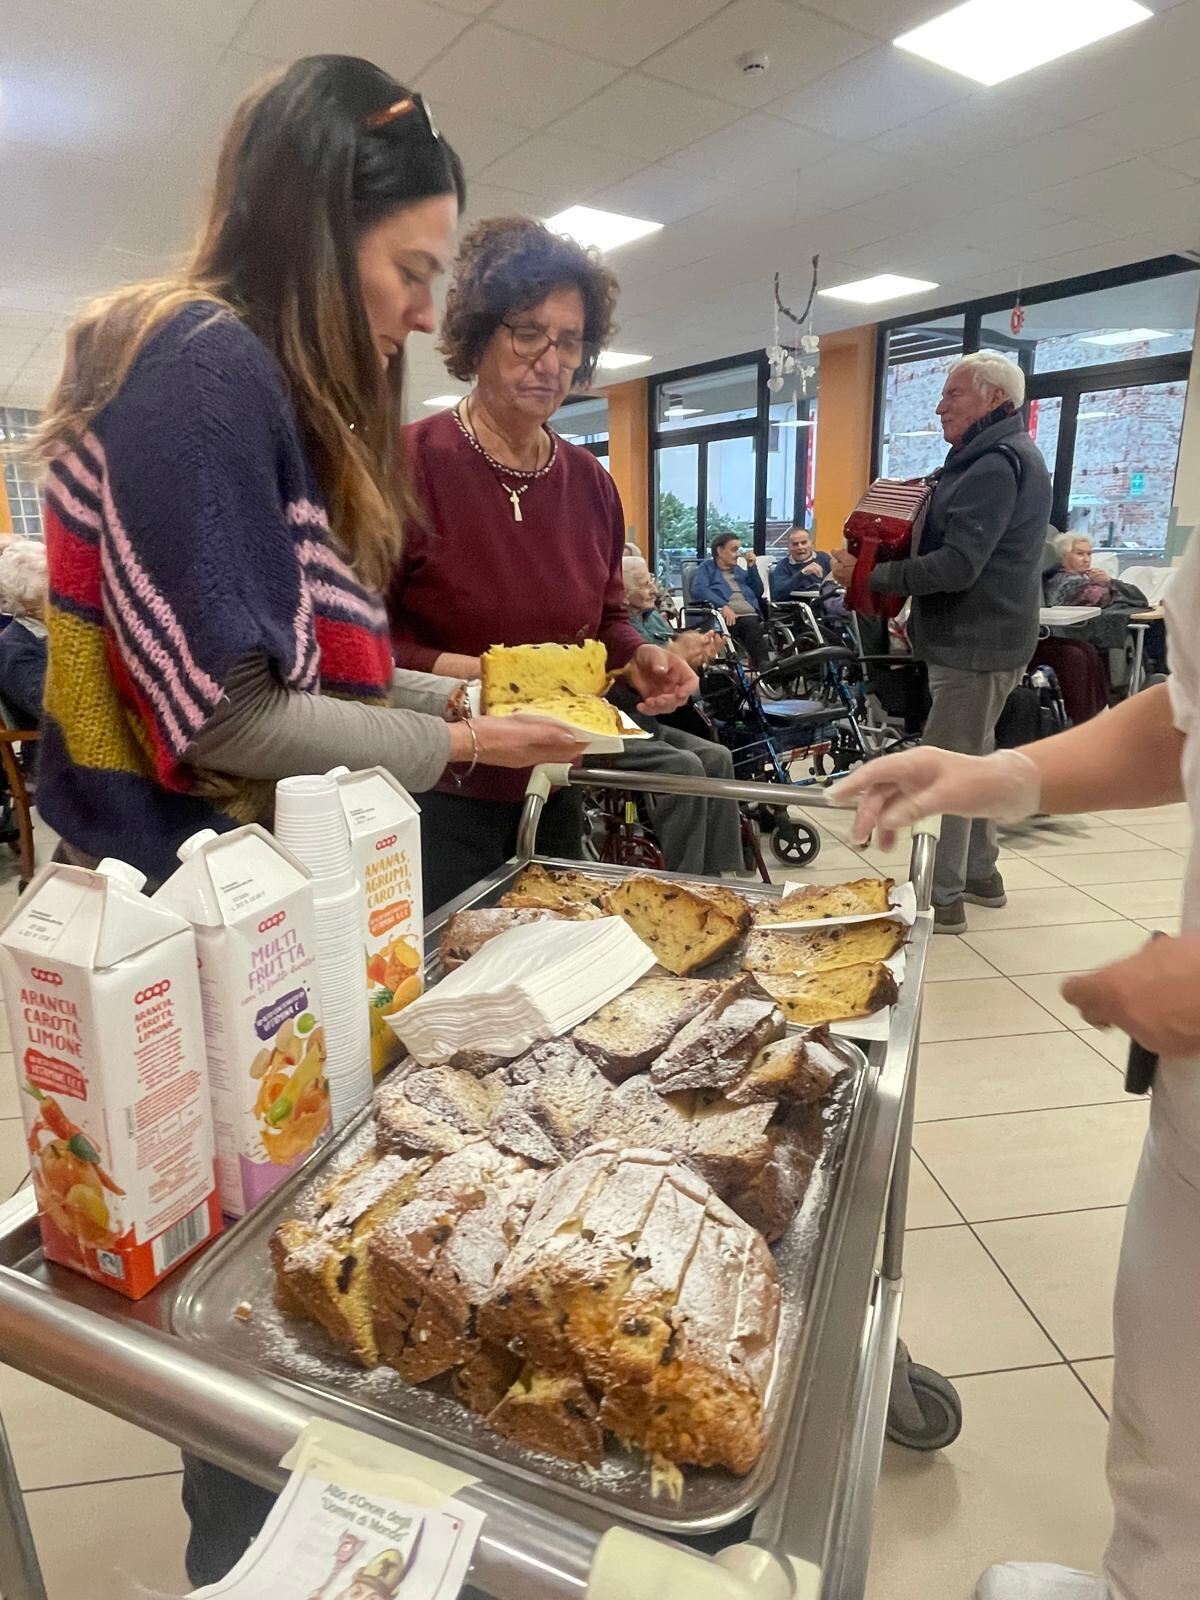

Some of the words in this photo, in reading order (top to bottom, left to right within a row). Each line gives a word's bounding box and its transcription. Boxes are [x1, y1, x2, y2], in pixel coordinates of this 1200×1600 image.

[375, 835, 397, 851] coop
[367, 879, 411, 909] CAROTA
[258, 910, 286, 933] coop
[251, 928, 297, 969] MULTI
[248, 943, 305, 991] FRUTTA
[134, 980, 171, 1005] coop
[28, 1026, 83, 1058] LIMONE
[138, 1019, 174, 1043] LIMONE
